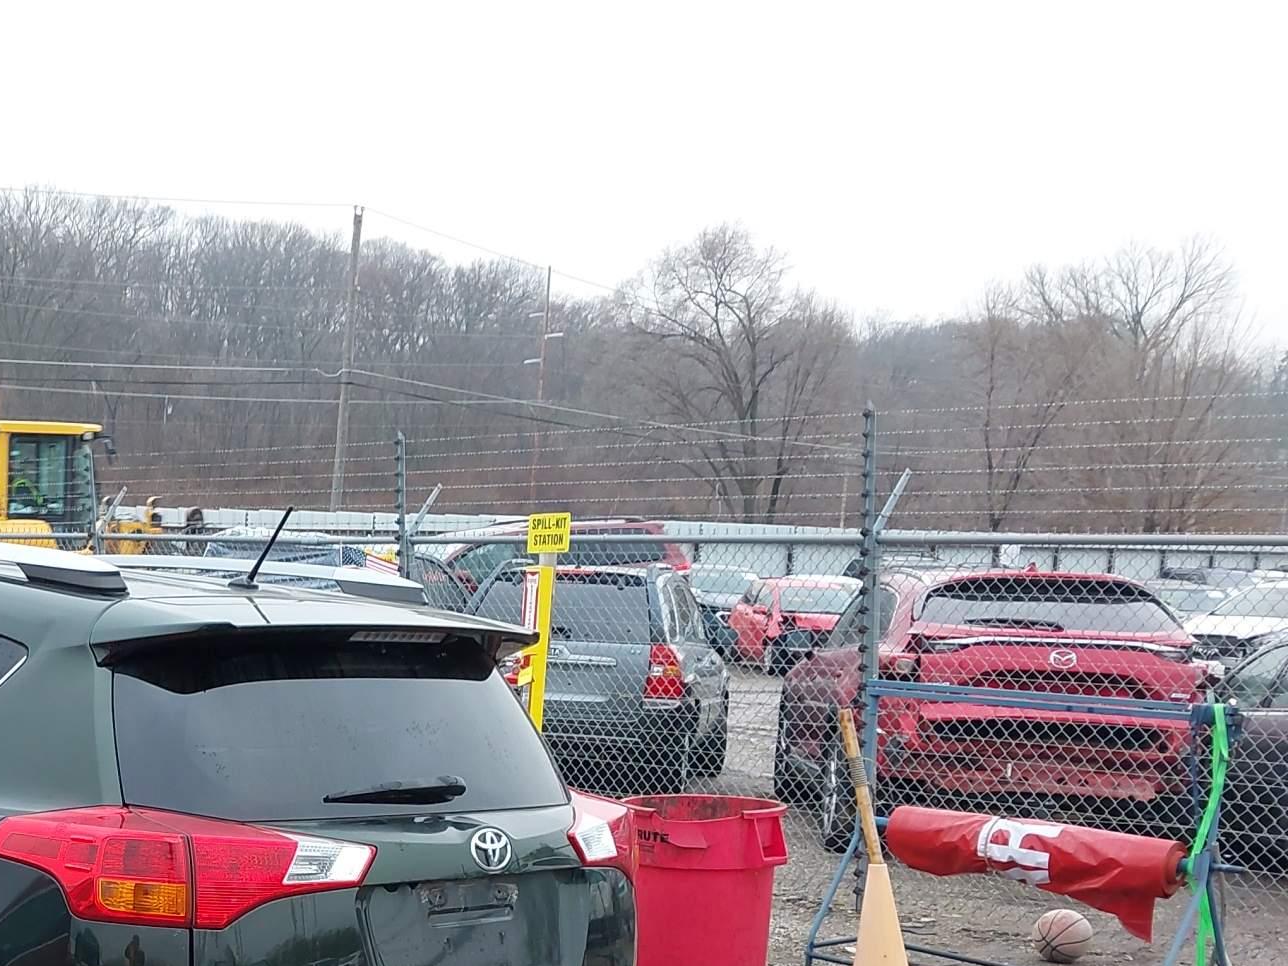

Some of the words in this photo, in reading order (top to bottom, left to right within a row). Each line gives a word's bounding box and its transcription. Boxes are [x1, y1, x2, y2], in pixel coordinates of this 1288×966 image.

[532, 517, 567, 530] SPILL-KIT
[533, 533, 564, 546] STATION
[637, 829, 669, 844] RUTE
